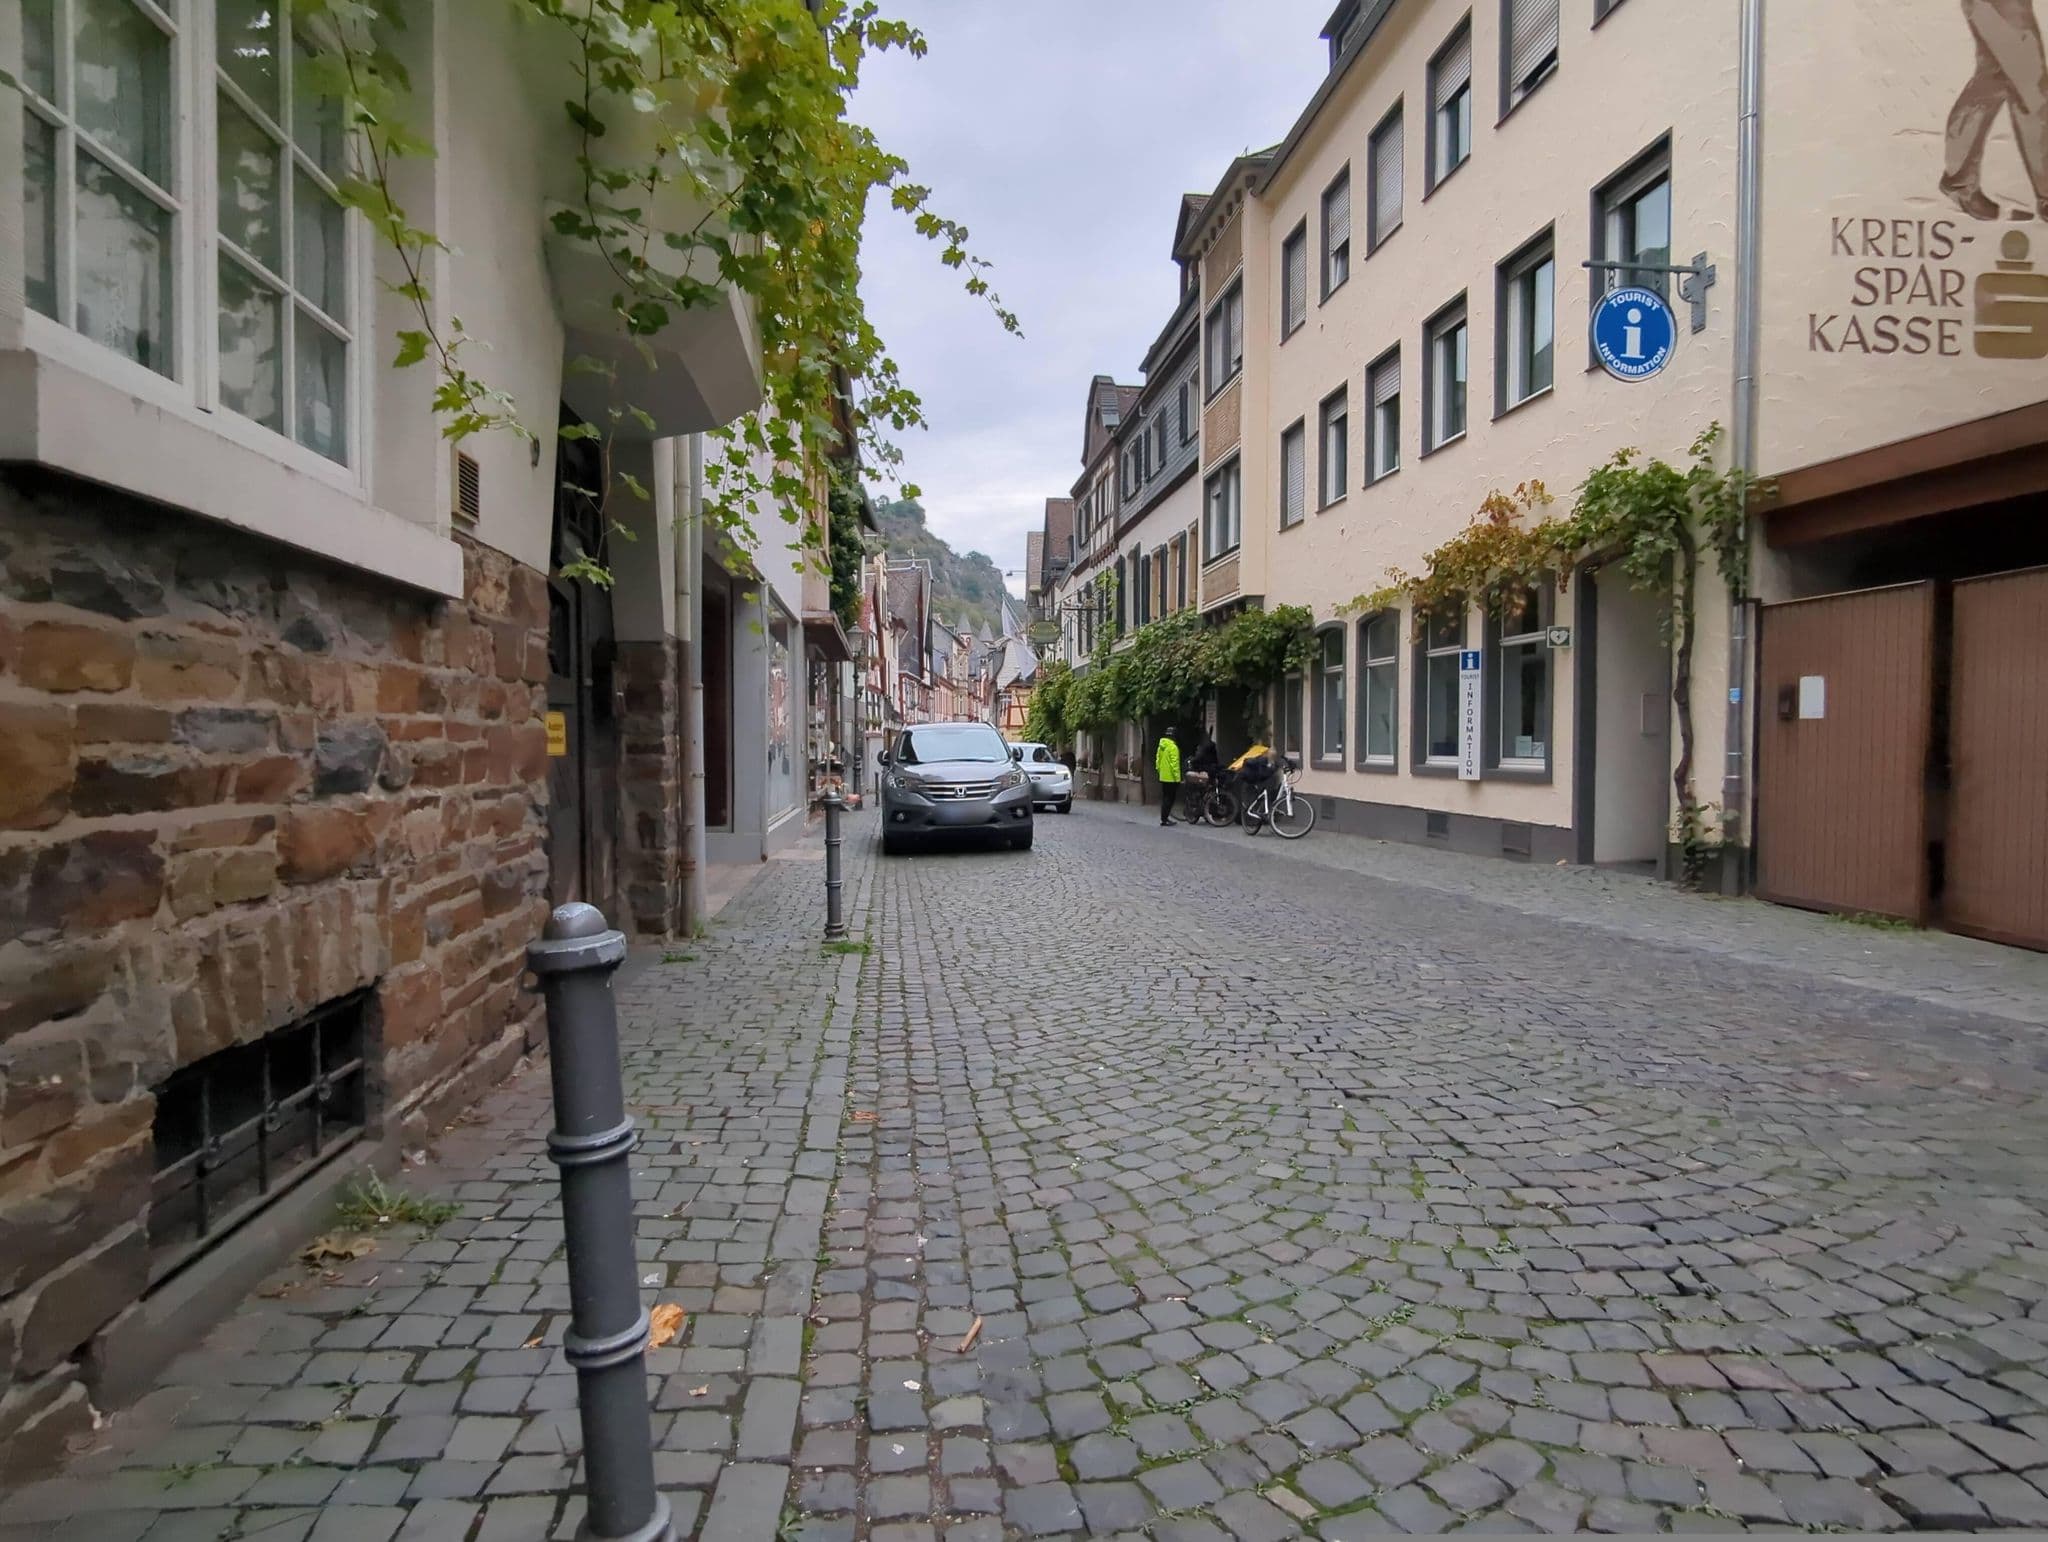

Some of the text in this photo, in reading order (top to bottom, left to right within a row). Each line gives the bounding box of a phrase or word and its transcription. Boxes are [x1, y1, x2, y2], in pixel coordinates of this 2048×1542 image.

[1831, 217, 1975, 260] KREIS-
[1609, 292, 1660, 311] TOURIST
[1851, 264, 1965, 307] SPAR
[1808, 313, 1962, 356] KASSE
[1600, 342, 1666, 374] INFORMATION
[1466, 683, 1474, 776] INFORMATION
